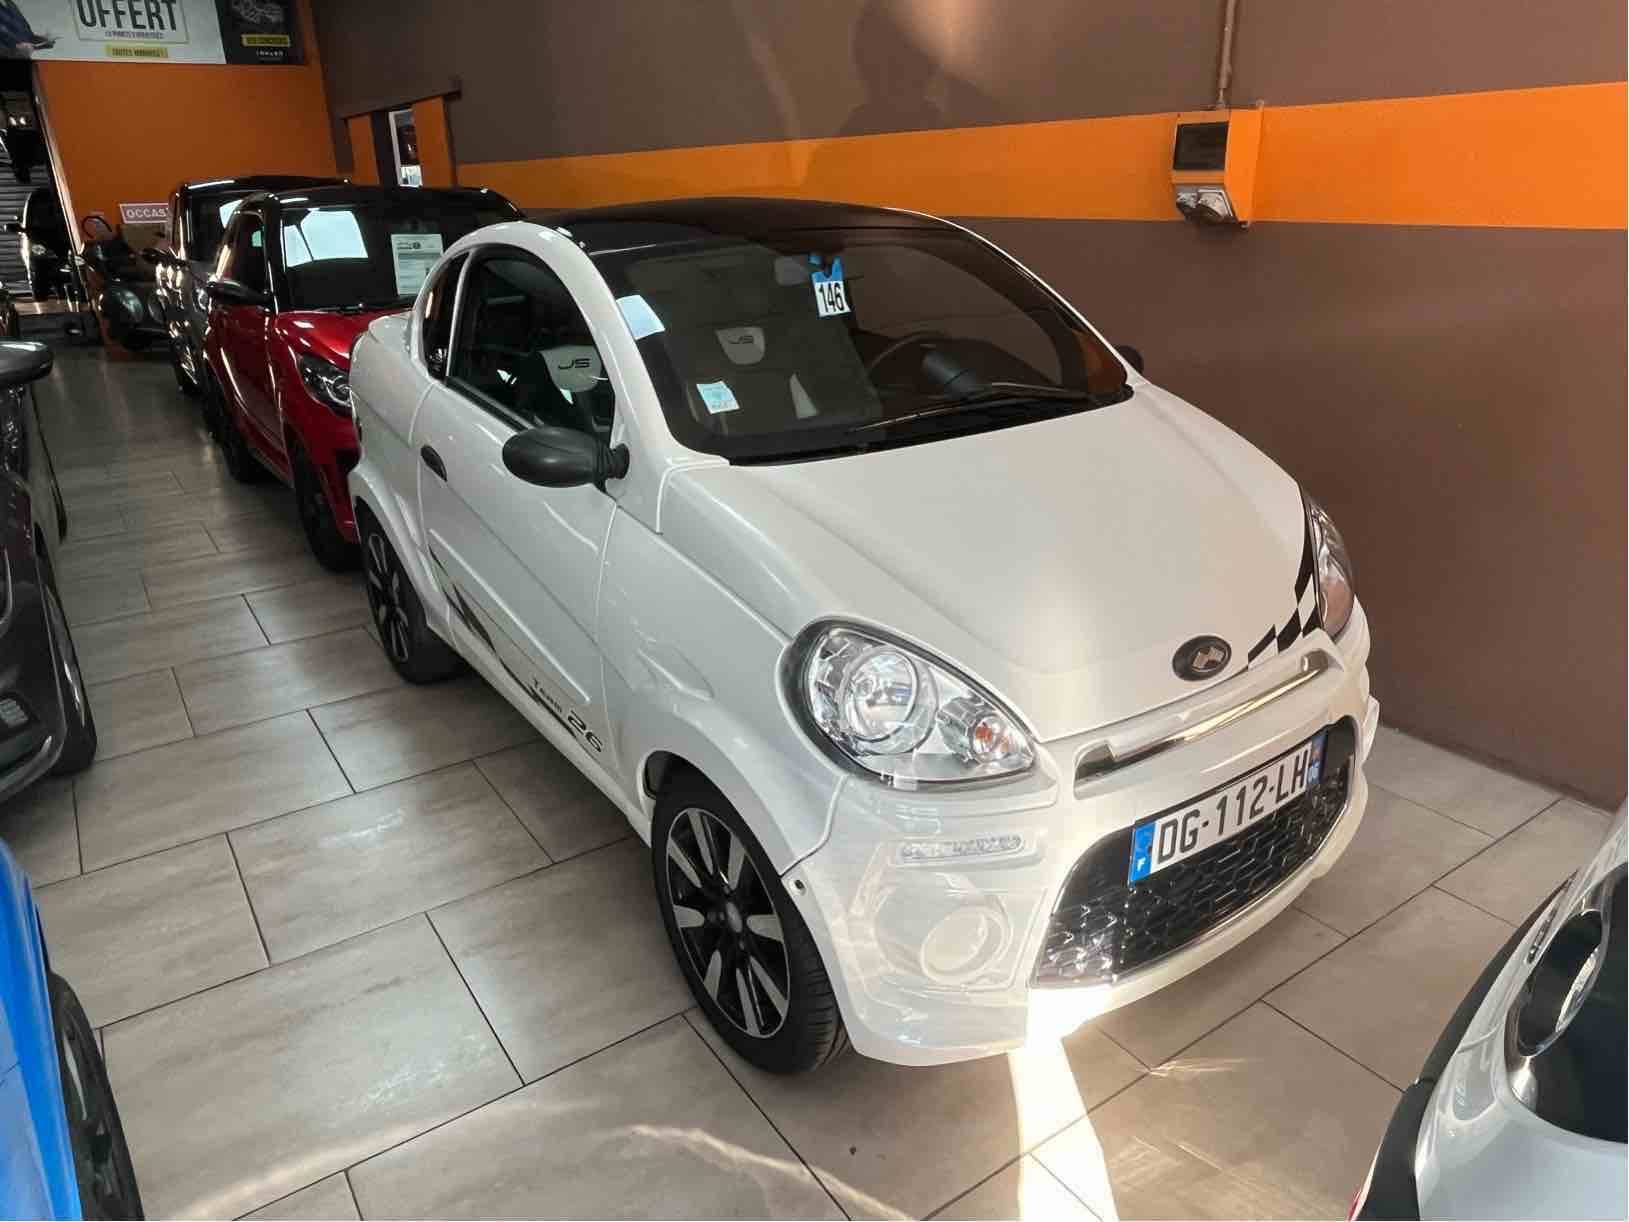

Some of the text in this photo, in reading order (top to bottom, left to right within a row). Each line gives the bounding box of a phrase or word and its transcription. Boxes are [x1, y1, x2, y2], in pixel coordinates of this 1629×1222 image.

[126, 208, 169, 218] OCCAS
[819, 282, 845, 313] 146
[558, 358, 591, 370] JS
[567, 709, 603, 752] 26
[1157, 748, 1309, 865] DG-112-LH
